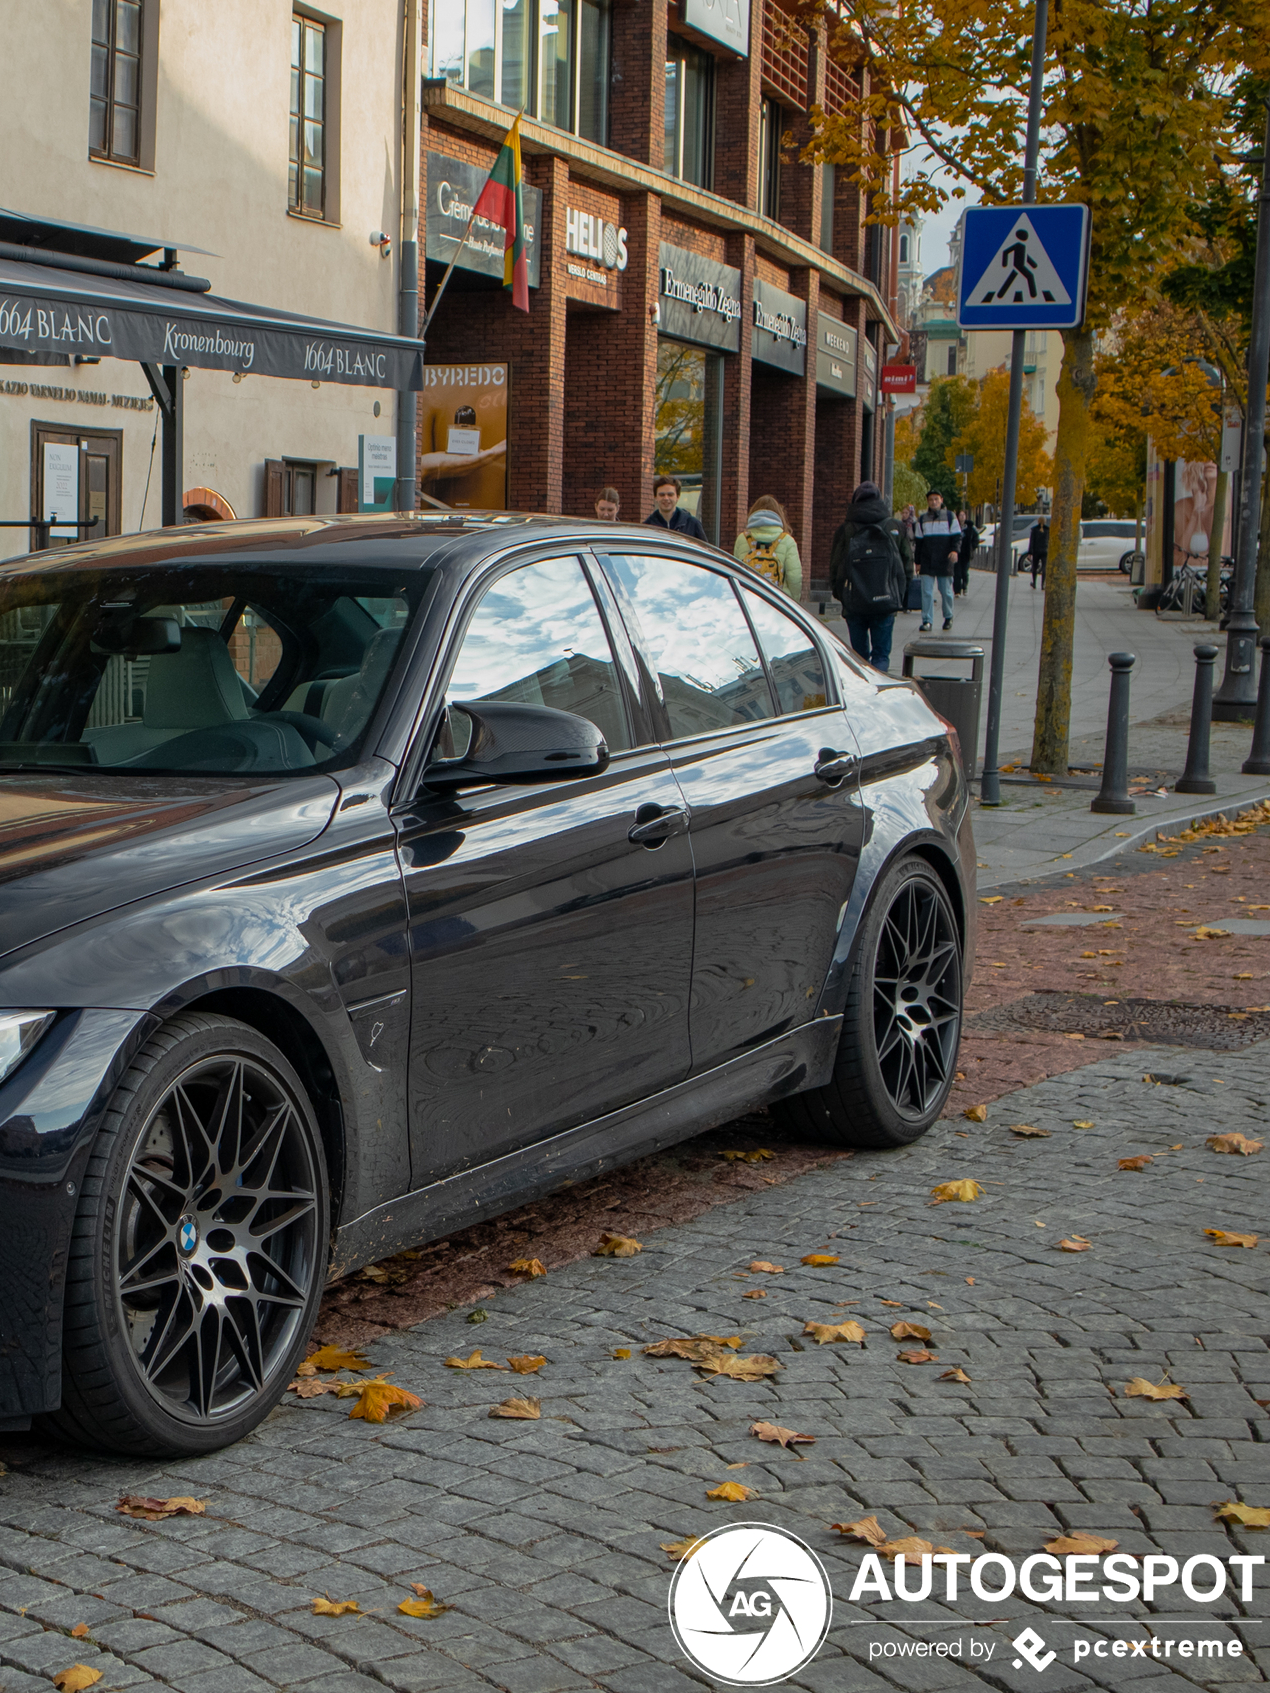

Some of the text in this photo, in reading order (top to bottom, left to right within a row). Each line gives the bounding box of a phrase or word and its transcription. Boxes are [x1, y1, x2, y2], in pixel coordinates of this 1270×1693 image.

[566, 206, 628, 271] HELIOS
[567, 263, 607, 285] VERSLO CENTRAS
[663, 268, 741, 324] Ermenegildo Zegna
[36, 308, 112, 345] BLANC
[163, 322, 255, 368] Kronenbourg
[755, 300, 807, 350] Ermenegildo Zegna
[826, 331, 850, 355] WEEKEND
[304, 340, 386, 379] 1664 BLANC
[425, 366, 505, 387] BYREDO
[102, 1203, 116, 1310] MICHELIN
